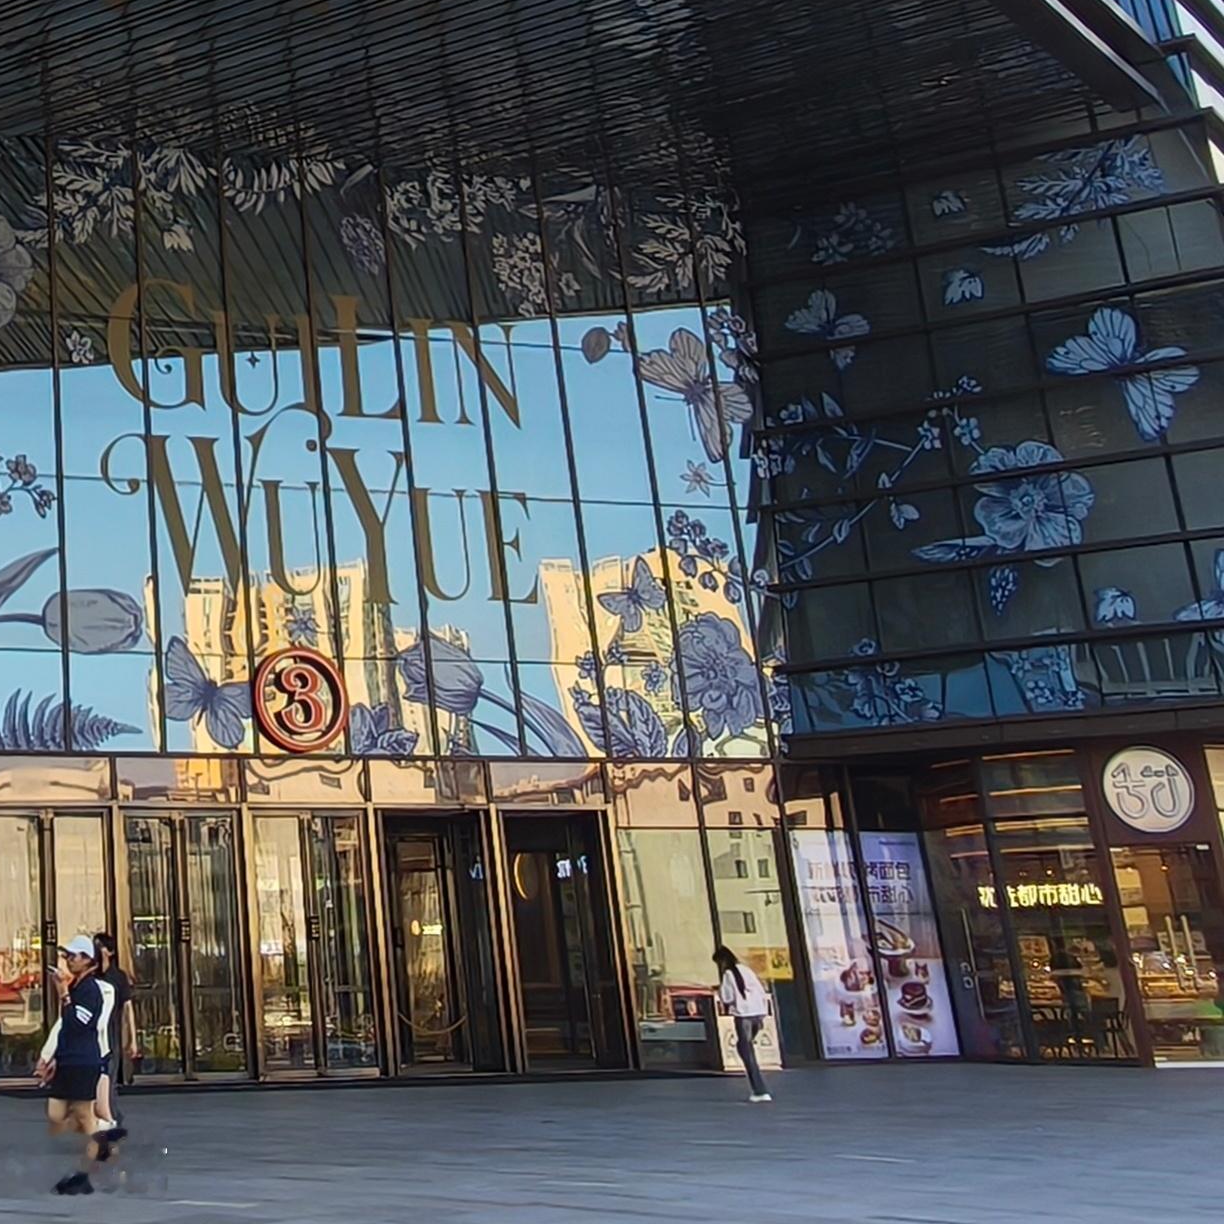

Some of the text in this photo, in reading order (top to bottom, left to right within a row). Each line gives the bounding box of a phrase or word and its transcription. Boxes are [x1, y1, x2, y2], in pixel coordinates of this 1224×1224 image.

[106, 277, 522, 430] GUILIN
[99, 402, 539, 605] WUYUE
[277, 662, 326, 733] 3
